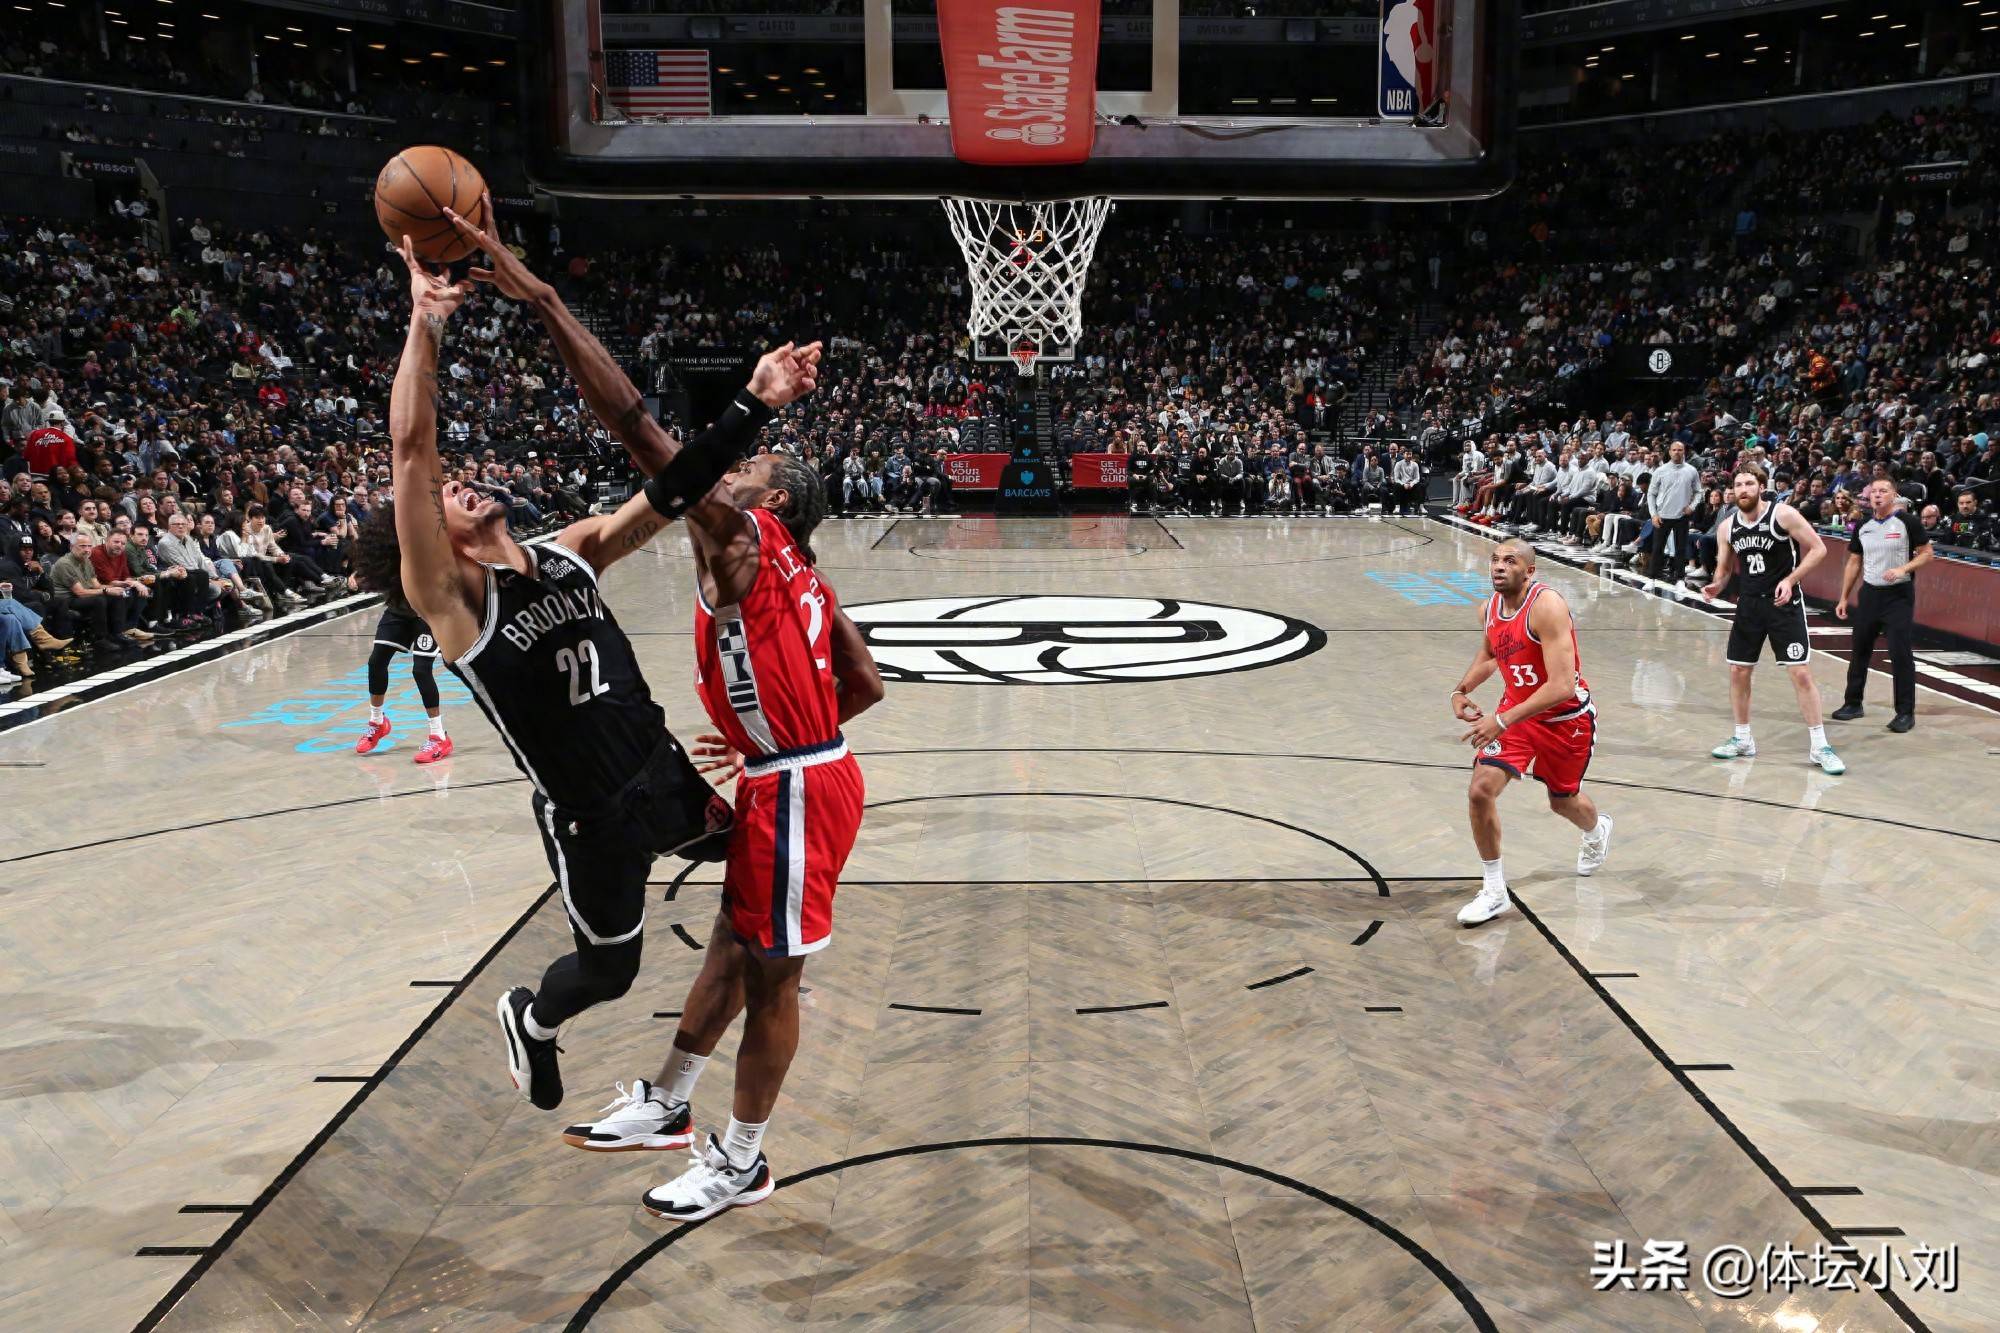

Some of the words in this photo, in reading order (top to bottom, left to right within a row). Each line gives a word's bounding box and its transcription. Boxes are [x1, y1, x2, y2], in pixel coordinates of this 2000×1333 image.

[1386, 89, 1412, 111] NBA
[93, 162, 136, 174] TISSOT
[950, 460, 969, 469] GET
[1100, 460, 1118, 468] GET
[1004, 488, 1052, 497] BARCLAYS
[540, 558, 557, 570] GET
[550, 564, 577, 580] GUIDE
[501, 588, 604, 652] BROOKLYN
[800, 591, 827, 670] 2
[556, 640, 610, 706] 22
[1509, 664, 1539, 687] 33
